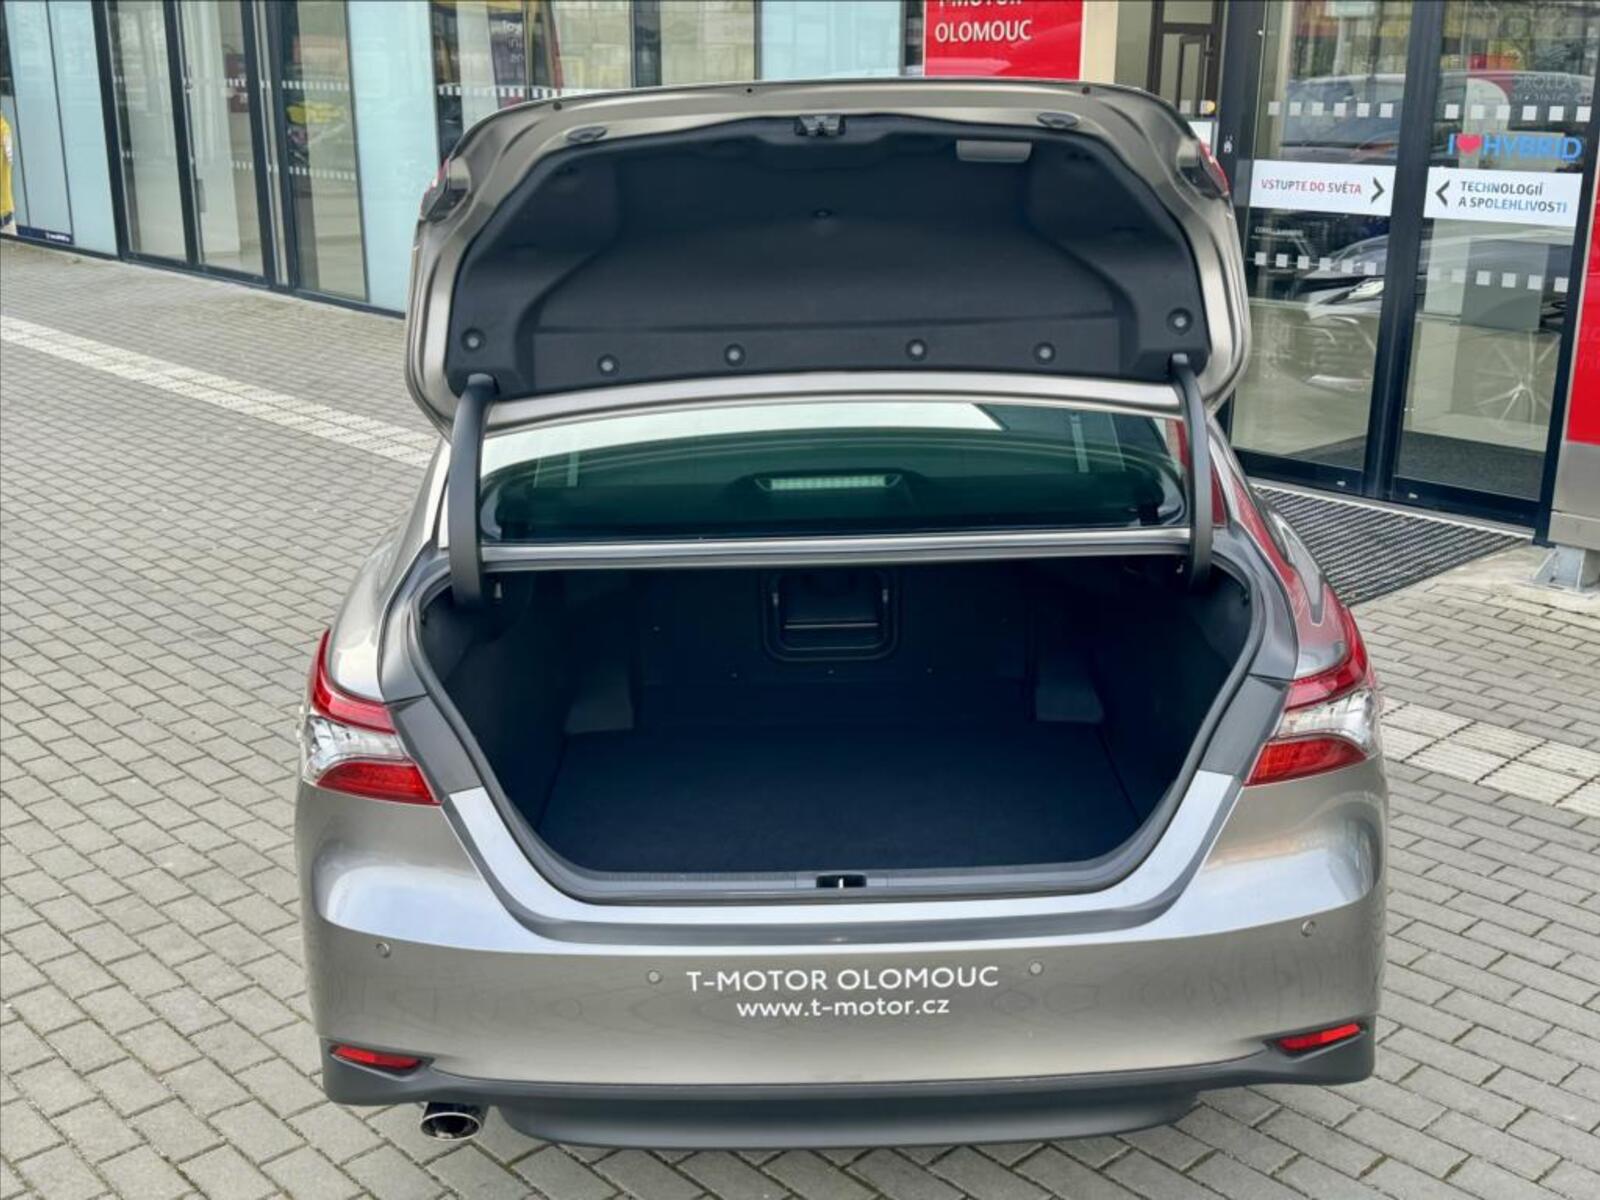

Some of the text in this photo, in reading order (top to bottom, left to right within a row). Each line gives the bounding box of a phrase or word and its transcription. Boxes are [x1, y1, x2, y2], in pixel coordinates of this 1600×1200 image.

[935, 19, 1032, 42] OLOMOUC
[1483, 134, 1583, 161] HYBRID
[1261, 179, 1308, 191] VSTUPTE
[1310, 181, 1325, 192] DO
[1461, 181, 1543, 196] TECHNOLOGIÍ
[1458, 197, 1567, 213] A SPOLEHLIVOSTI
[686, 966, 999, 992] T-MOTOR OLOMOUC
[736, 998, 950, 1017] www.t-motor.cz
